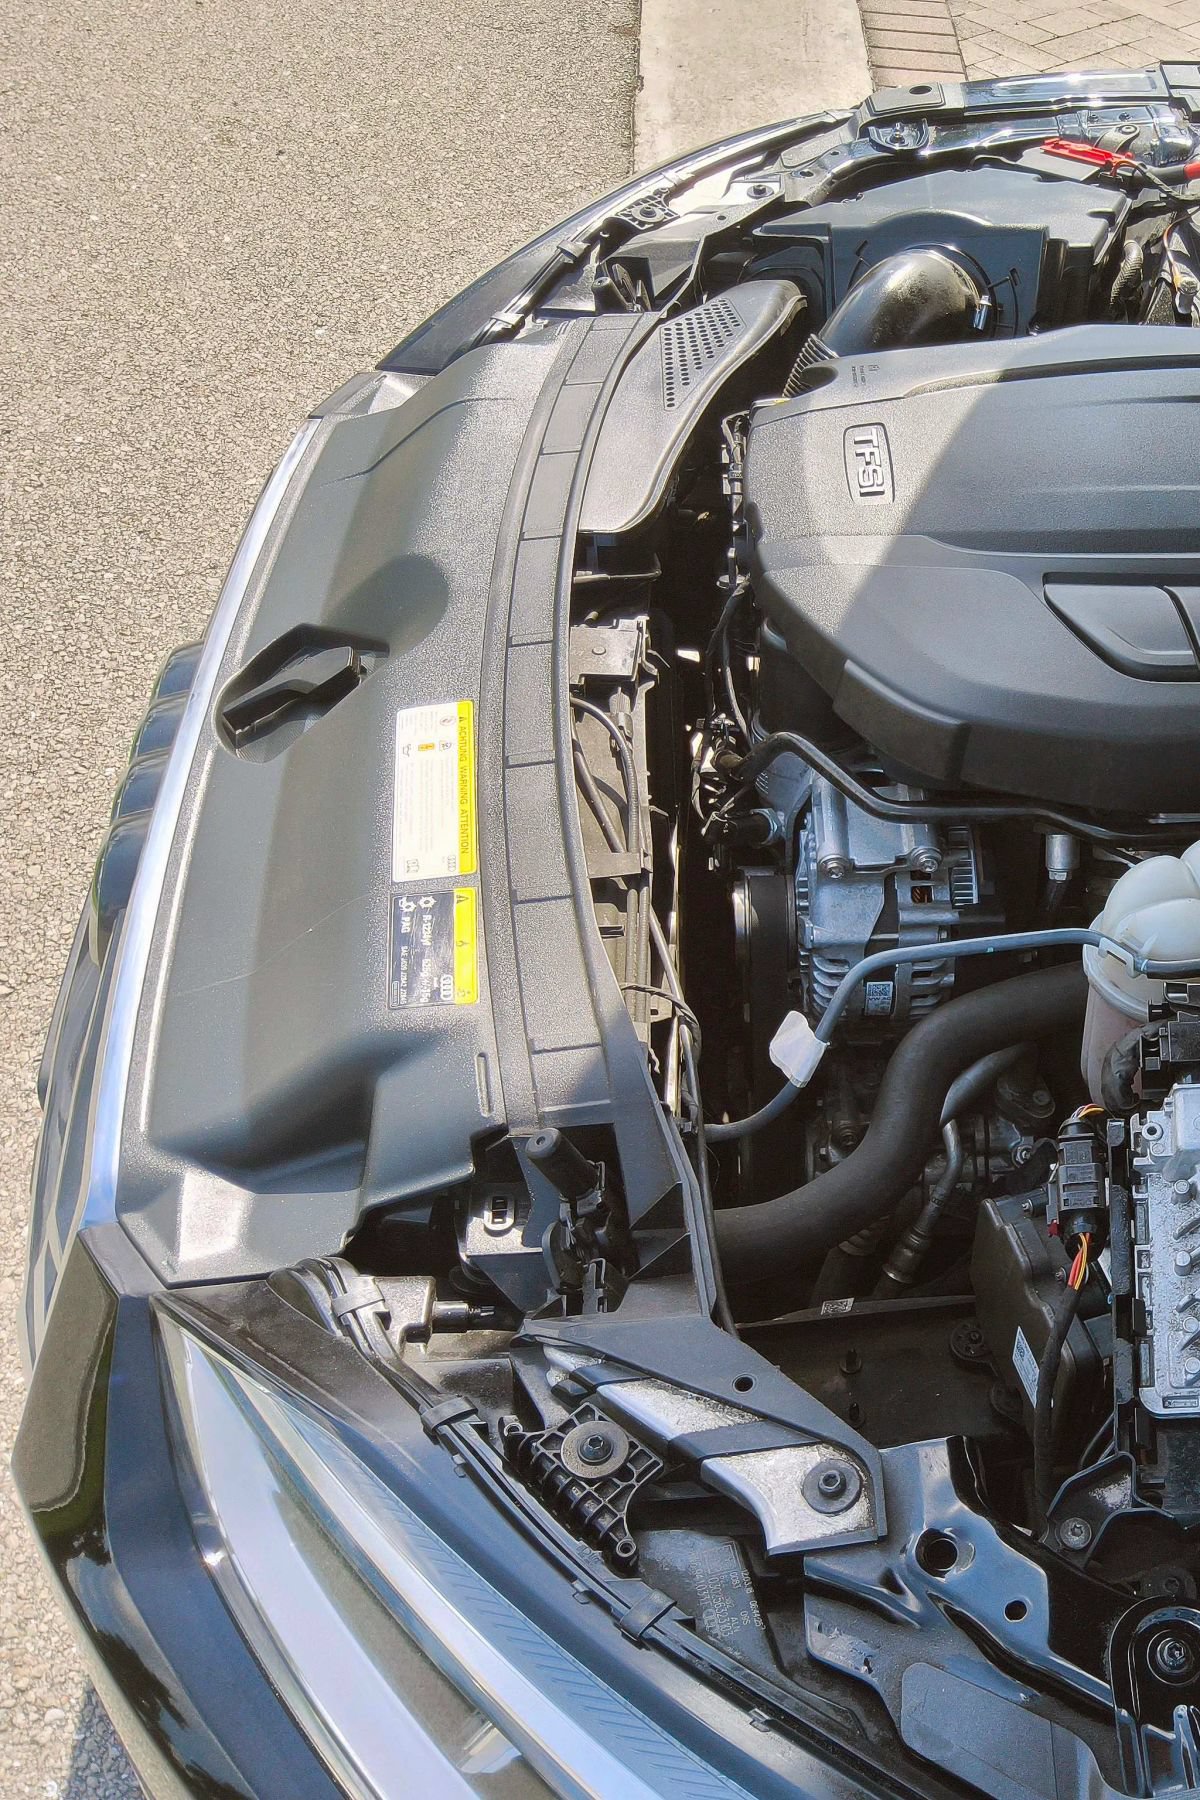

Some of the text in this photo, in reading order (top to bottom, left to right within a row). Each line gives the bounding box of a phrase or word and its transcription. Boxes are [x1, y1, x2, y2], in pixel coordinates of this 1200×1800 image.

[853, 427, 886, 497] TFSI
[458, 726, 469, 854] ACHTUNG WARNING ATTENTION
[401, 916, 410, 934] PAG
